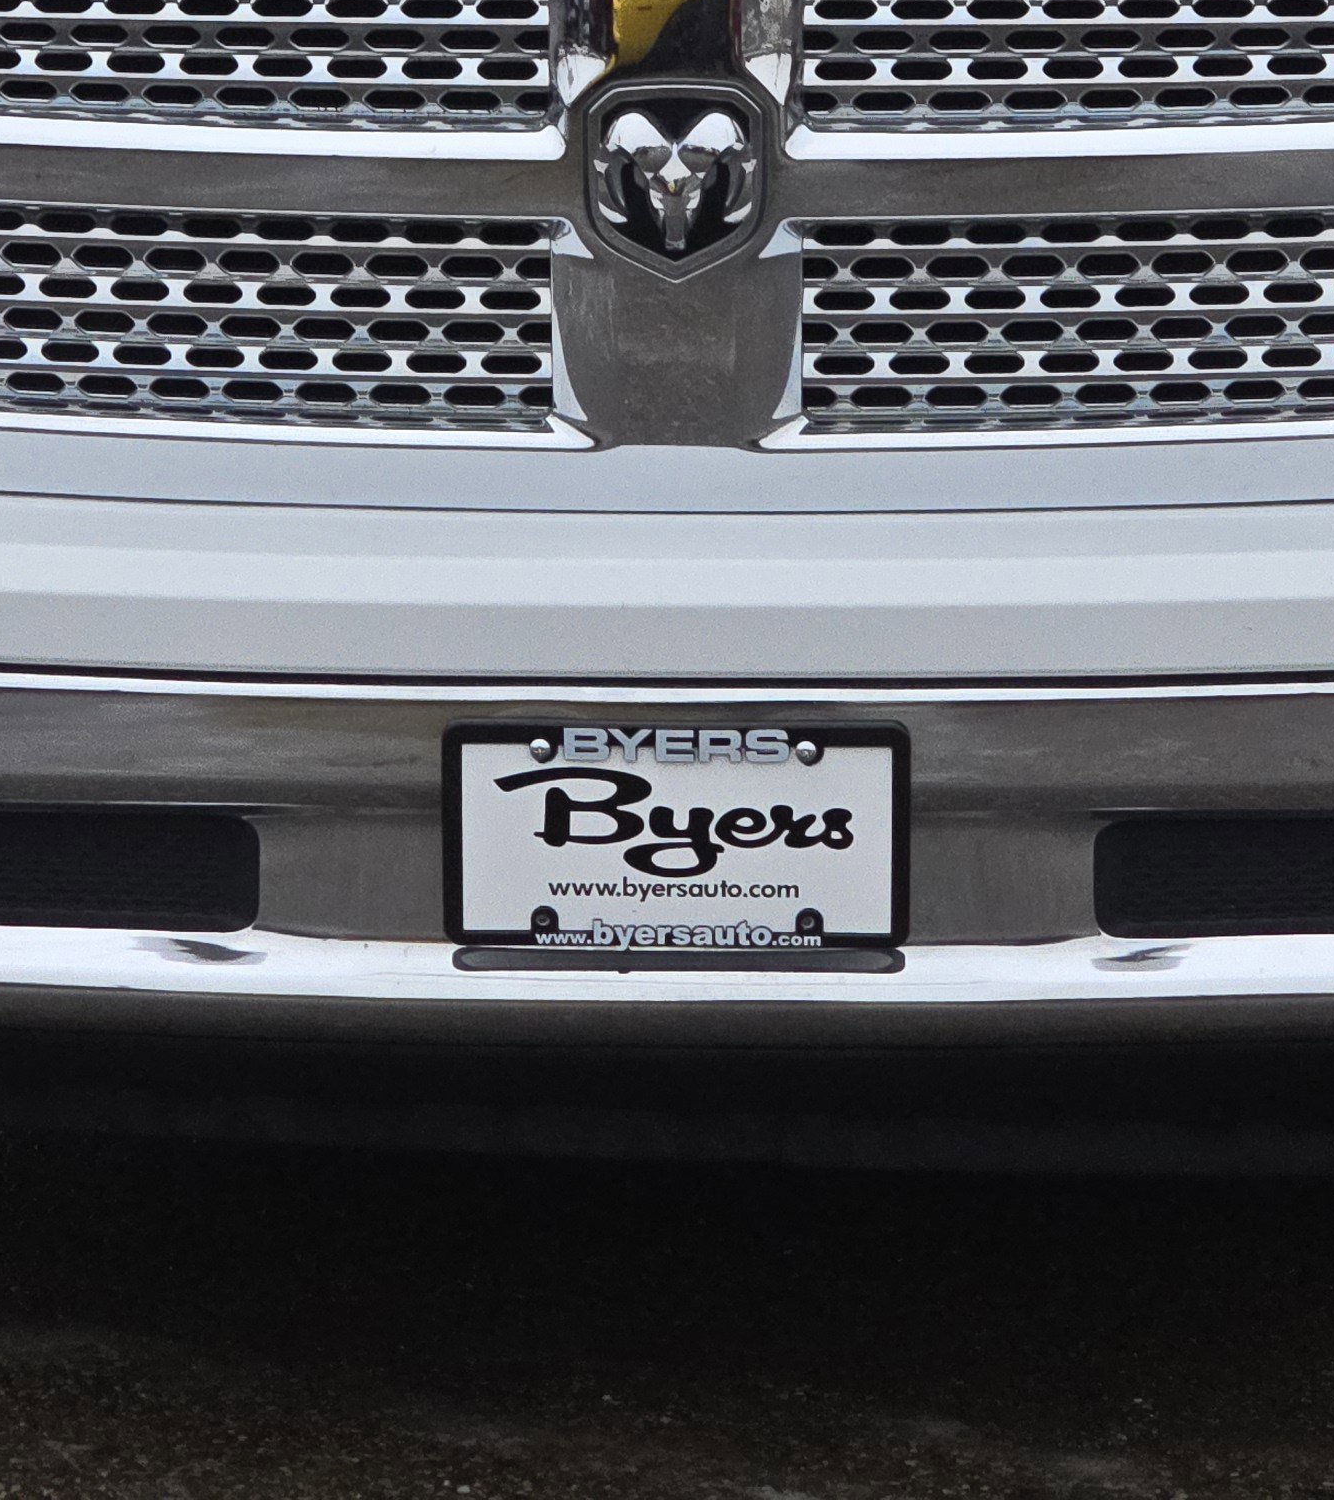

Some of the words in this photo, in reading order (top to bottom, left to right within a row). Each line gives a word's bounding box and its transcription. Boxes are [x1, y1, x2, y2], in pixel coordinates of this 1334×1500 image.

[563, 727, 791, 763] BYERS
[494, 767, 854, 877] Byers
[548, 877, 799, 902] www.byersauto.com
[535, 920, 821, 951] www.byersauto.com
